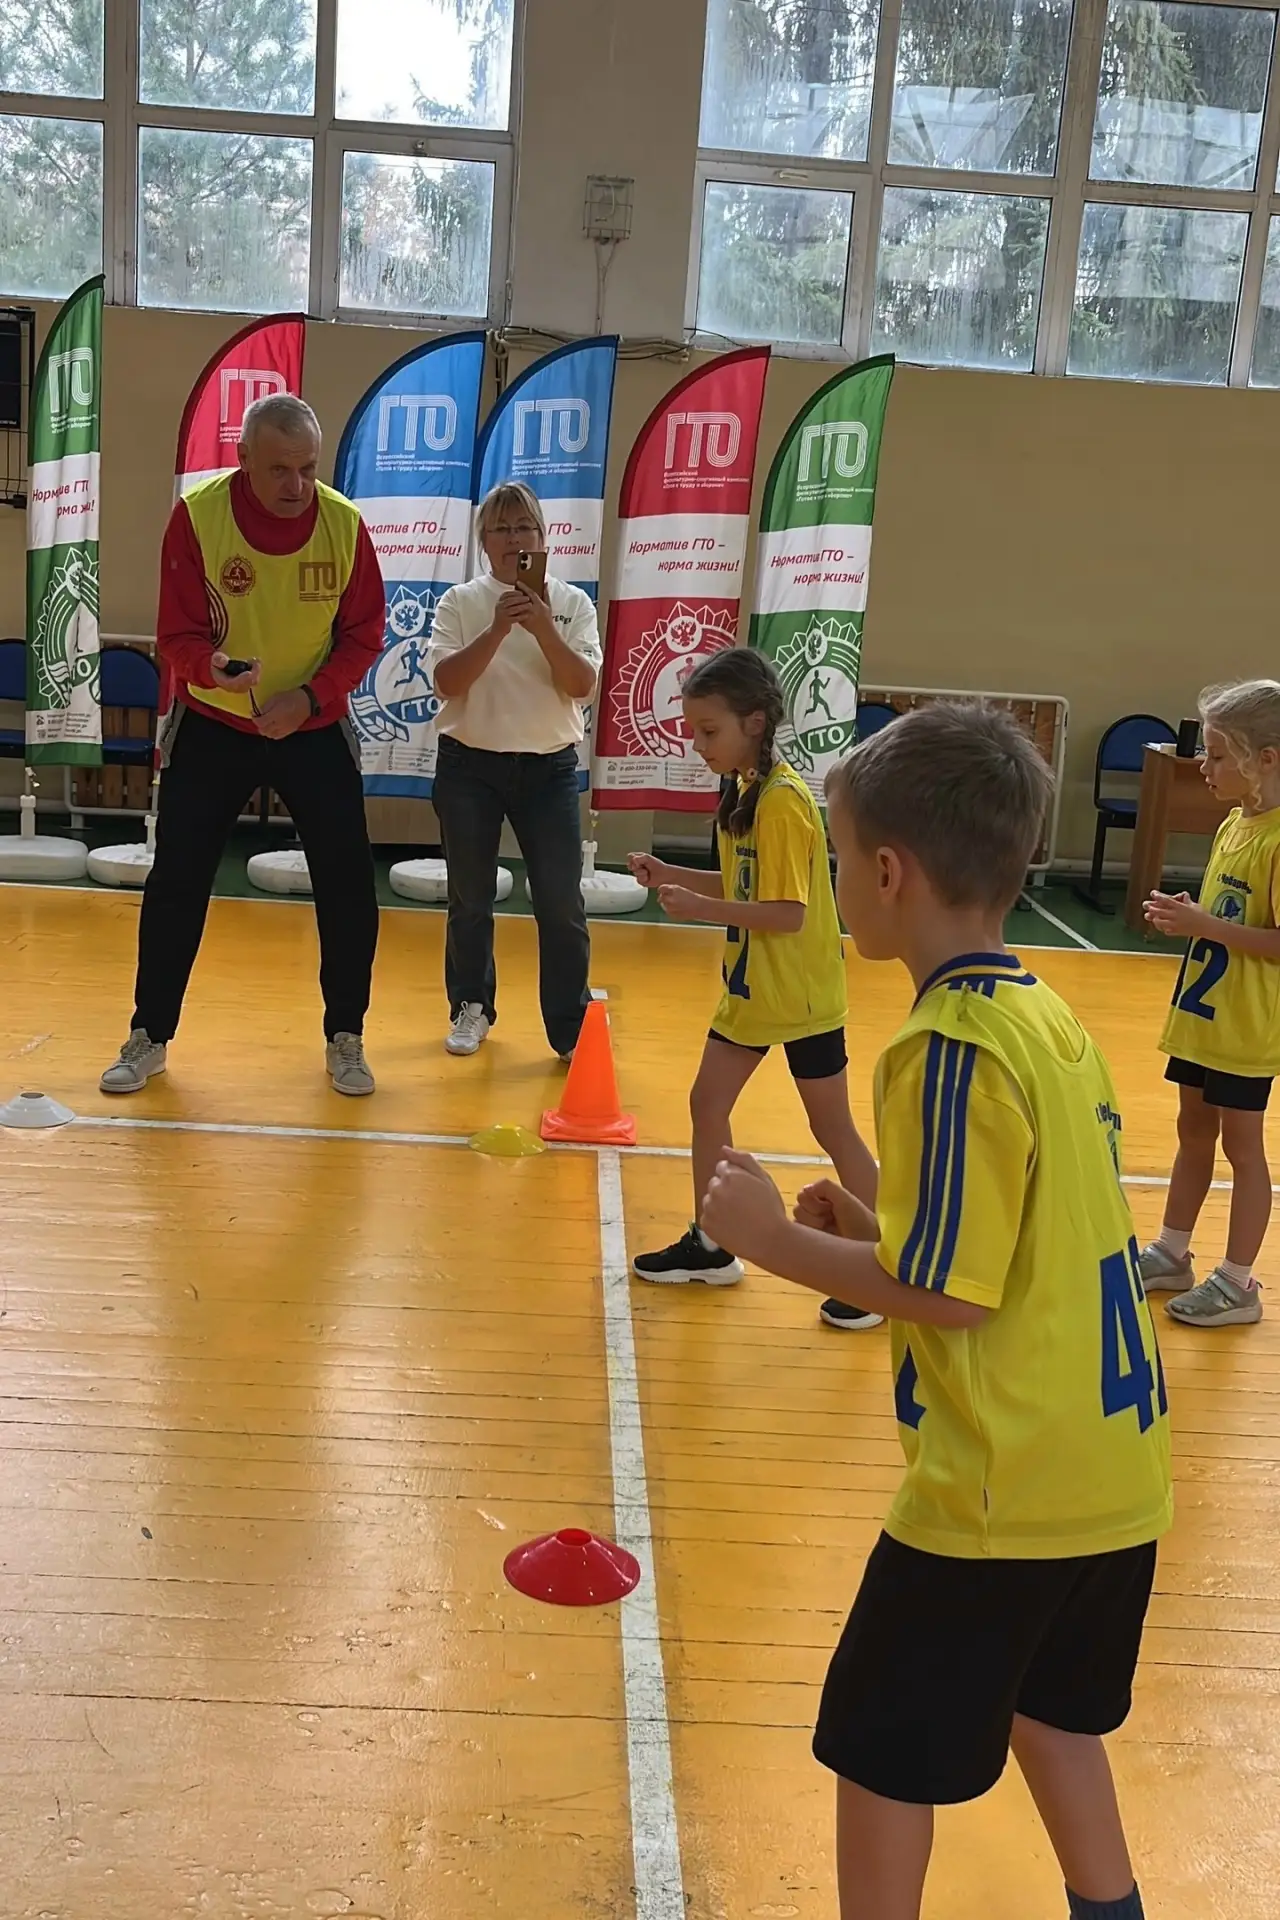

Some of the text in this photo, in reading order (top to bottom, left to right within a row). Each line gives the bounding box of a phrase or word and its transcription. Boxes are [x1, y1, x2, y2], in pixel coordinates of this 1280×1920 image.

[377, 394, 458, 452] ГТО
[512, 398, 591, 456] ГТО
[664, 412, 742, 469] ГТО
[798, 421, 869, 482] ГТО
[367, 524, 410, 534] матив
[412, 521, 438, 534] ГТО
[547, 522, 572, 535] ГТО
[375, 544, 463, 557] норма жизни!
[552, 542, 596, 555] жизни!
[628, 541, 689, 555] Норматив
[691, 538, 715, 551] ГТО
[820, 549, 844, 562] ГТО
[657, 559, 740, 573] норма жизни!
[299, 562, 337, 592] ГТО
[822, 571, 865, 584] жизни!
[400, 695, 442, 721] ГТО
[807, 725, 846, 751] ГТО
